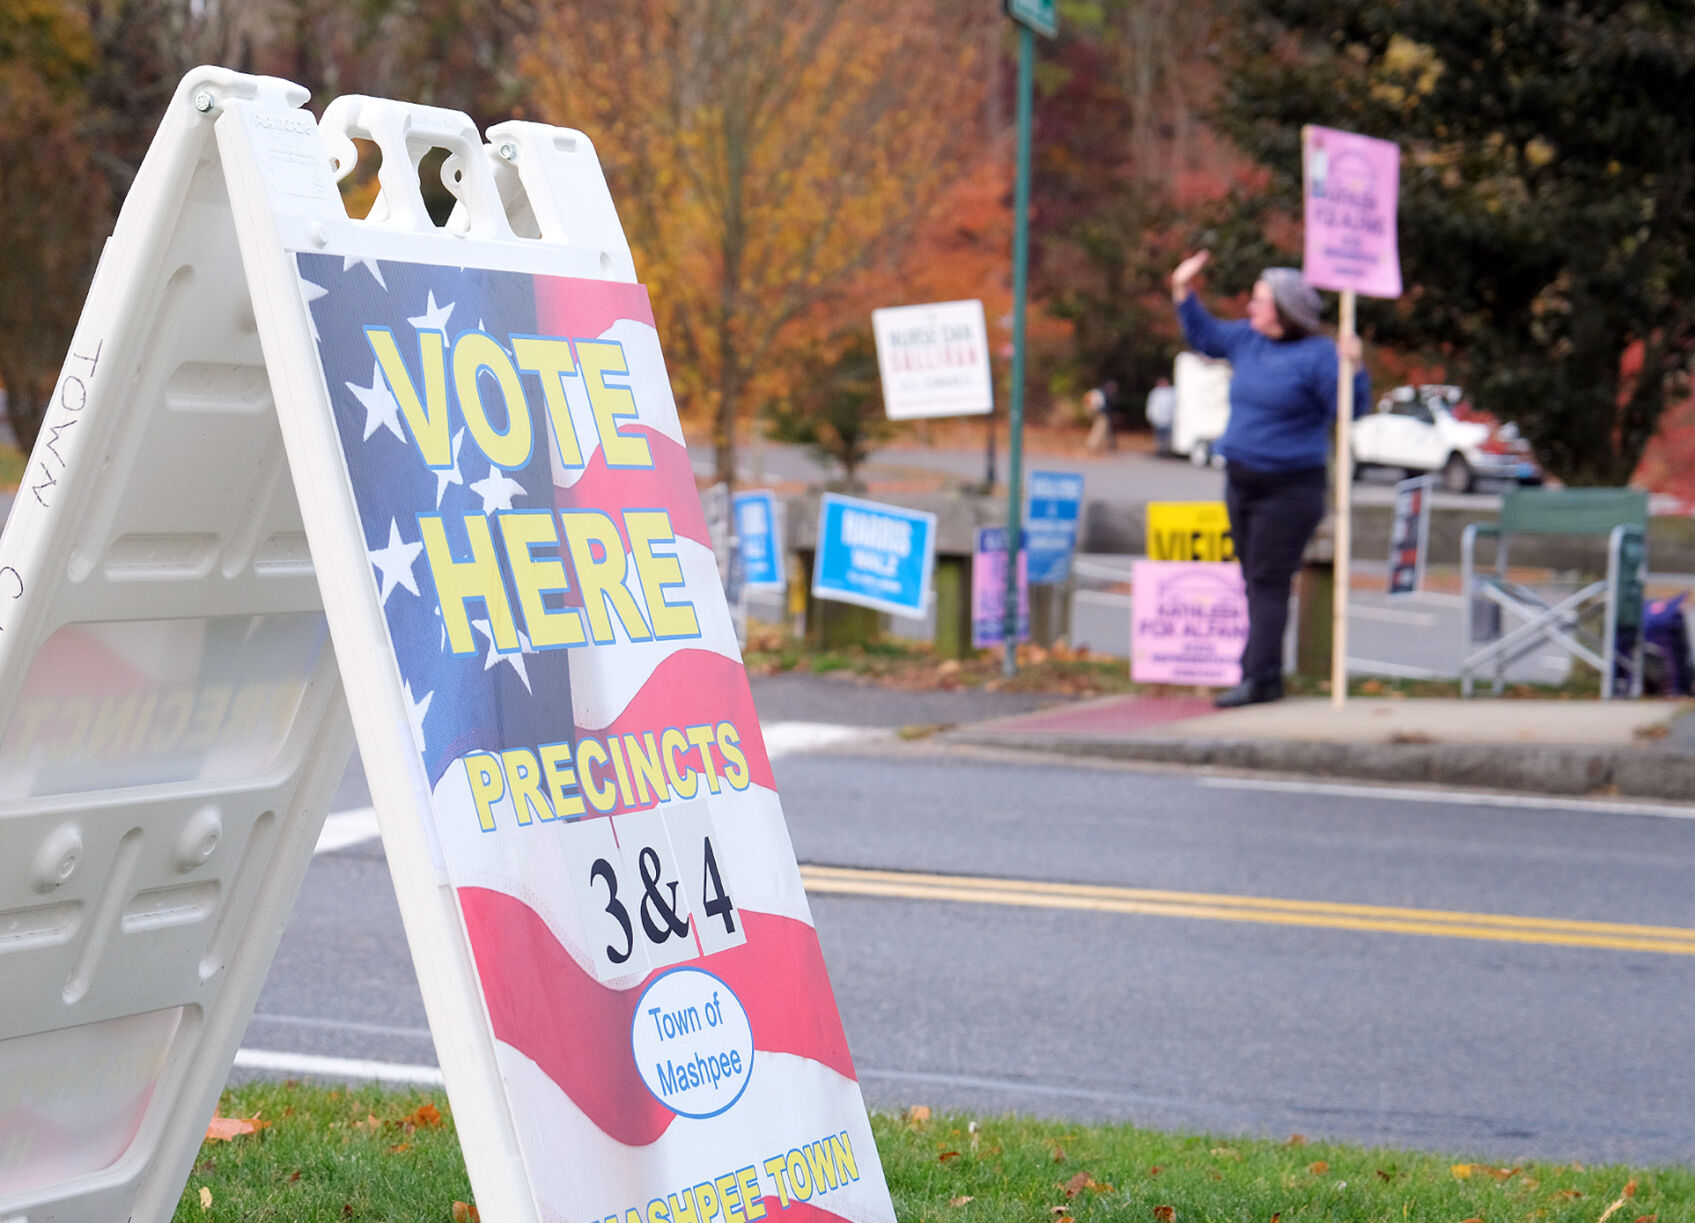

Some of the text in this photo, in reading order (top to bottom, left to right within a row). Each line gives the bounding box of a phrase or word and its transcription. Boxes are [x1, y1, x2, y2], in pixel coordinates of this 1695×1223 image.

[32, 339, 102, 507] TOWN
[363, 325, 655, 471] VOTE
[415, 508, 702, 659] HERE
[463, 720, 750, 832] PRECINCTS
[648, 991, 723, 1042] Town of
[656, 1049, 742, 1097] Mashpee
[763, 1130, 860, 1210] TOWN
